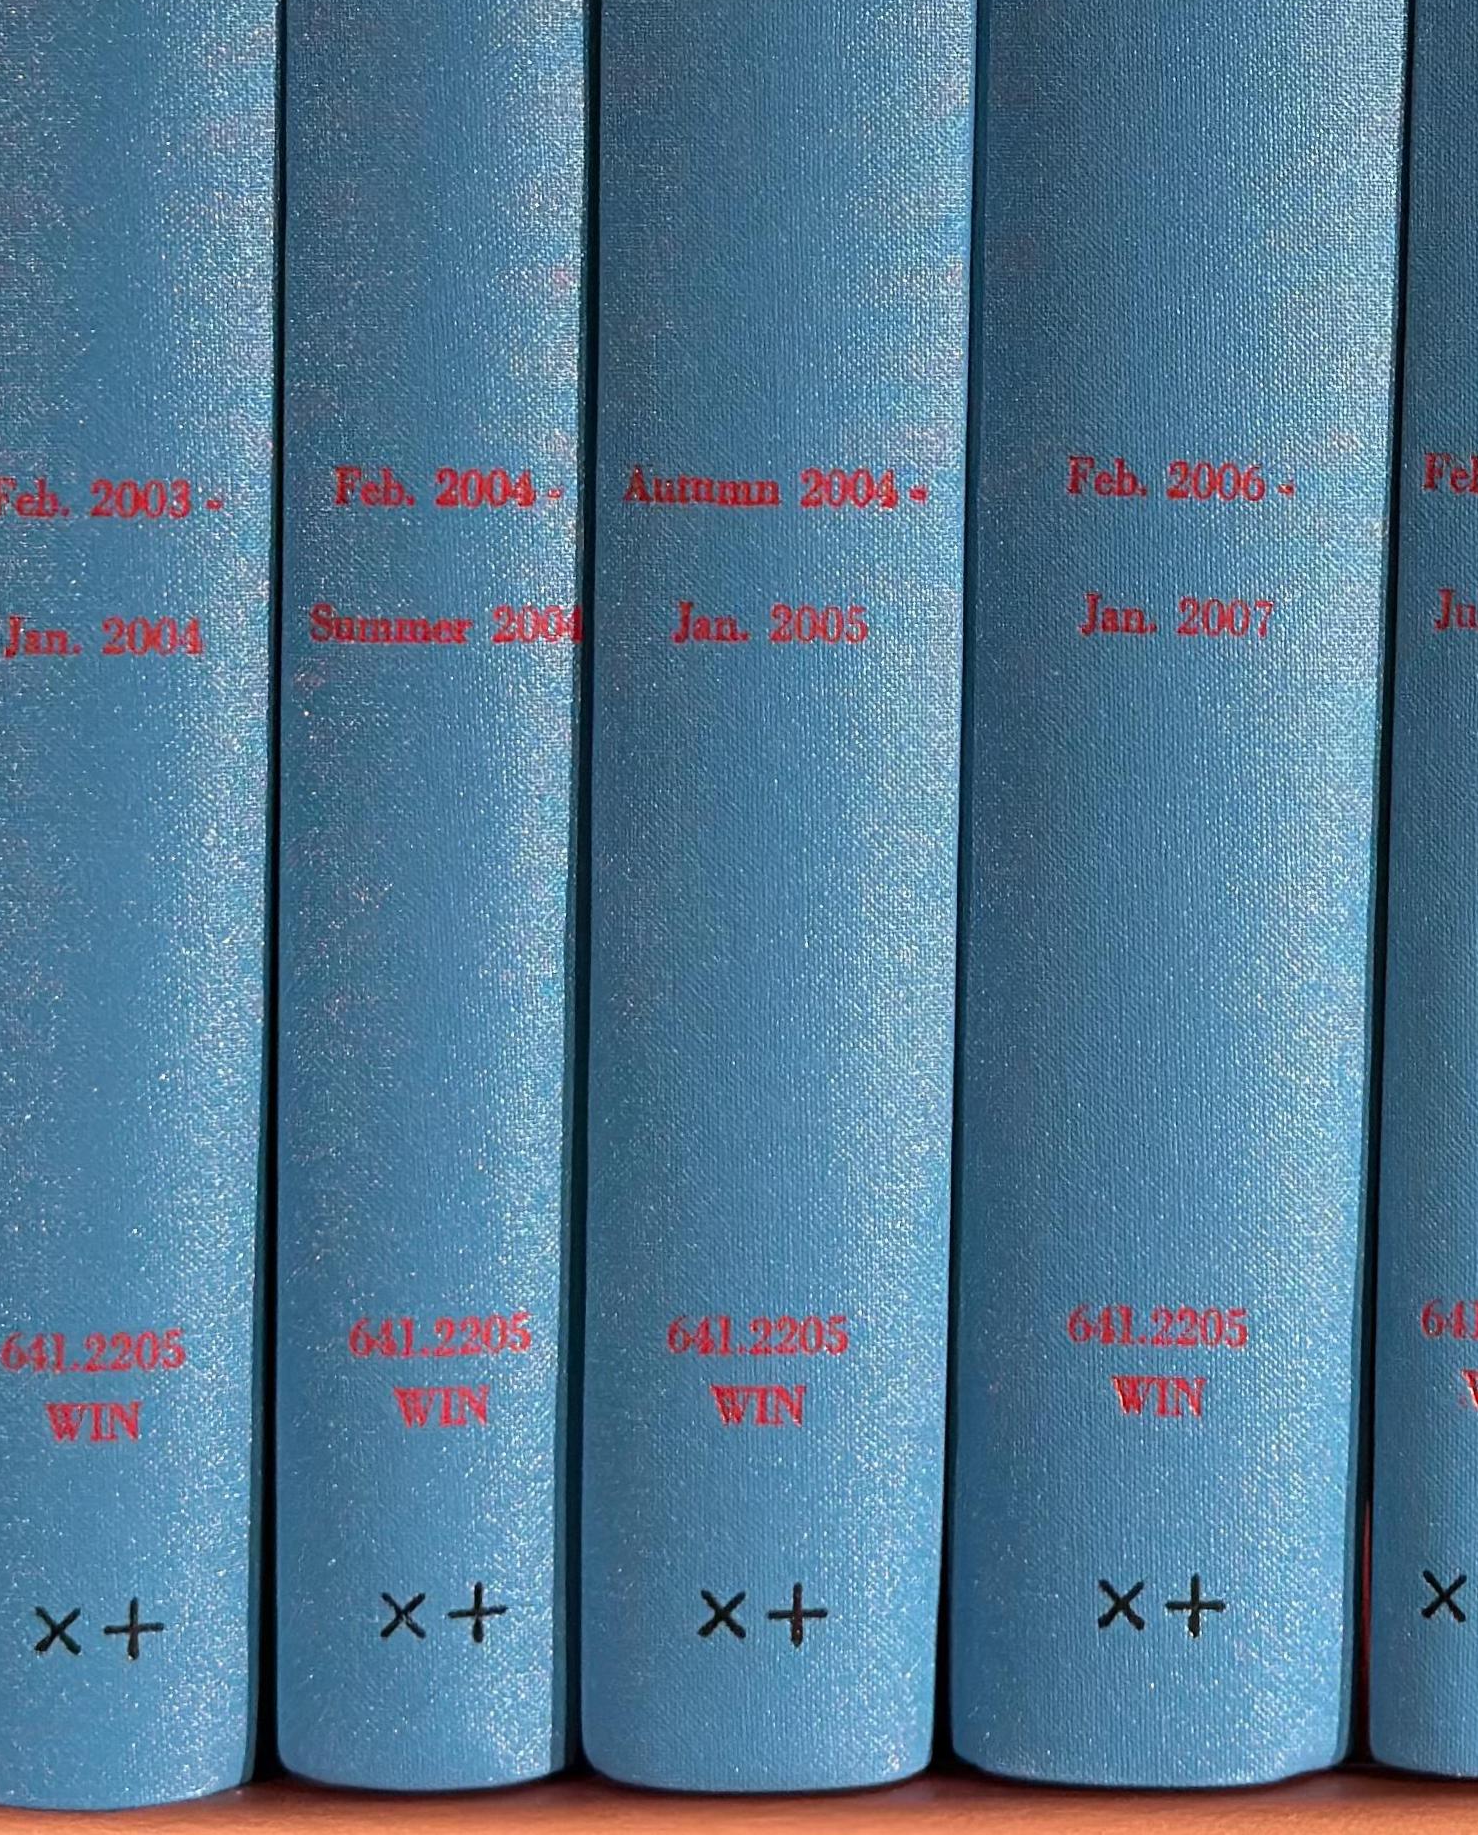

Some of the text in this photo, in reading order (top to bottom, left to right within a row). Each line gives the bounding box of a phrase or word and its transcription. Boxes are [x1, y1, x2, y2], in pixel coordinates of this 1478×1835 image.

[90, 478, 191, 519] 2003
[334, 466, 416, 508] Feb.
[436, 467, 536, 509] 2004
[624, 466, 781, 508] Autumn
[800, 468, 899, 509] 2004
[1068, 456, 1148, 497] Feb.
[1166, 460, 1267, 502] 2006
[309, 603, 473, 645] Summer
[672, 601, 870, 644] Jan. 2005
[1079, 591, 1274, 639] Jan. 2007
[4, 615, 204, 660] Jan. 2004
[350, 1313, 533, 1359] 641.2205
[668, 1316, 850, 1358] 641.2205
[1068, 1306, 1249, 1349] 641.2205
[1, 1330, 187, 1374] 641.2205
[394, 1385, 490, 1429] WIN
[710, 1386, 807, 1427] WIN
[1112, 1376, 1208, 1418] WIN
[47, 1402, 141, 1443] WIN
